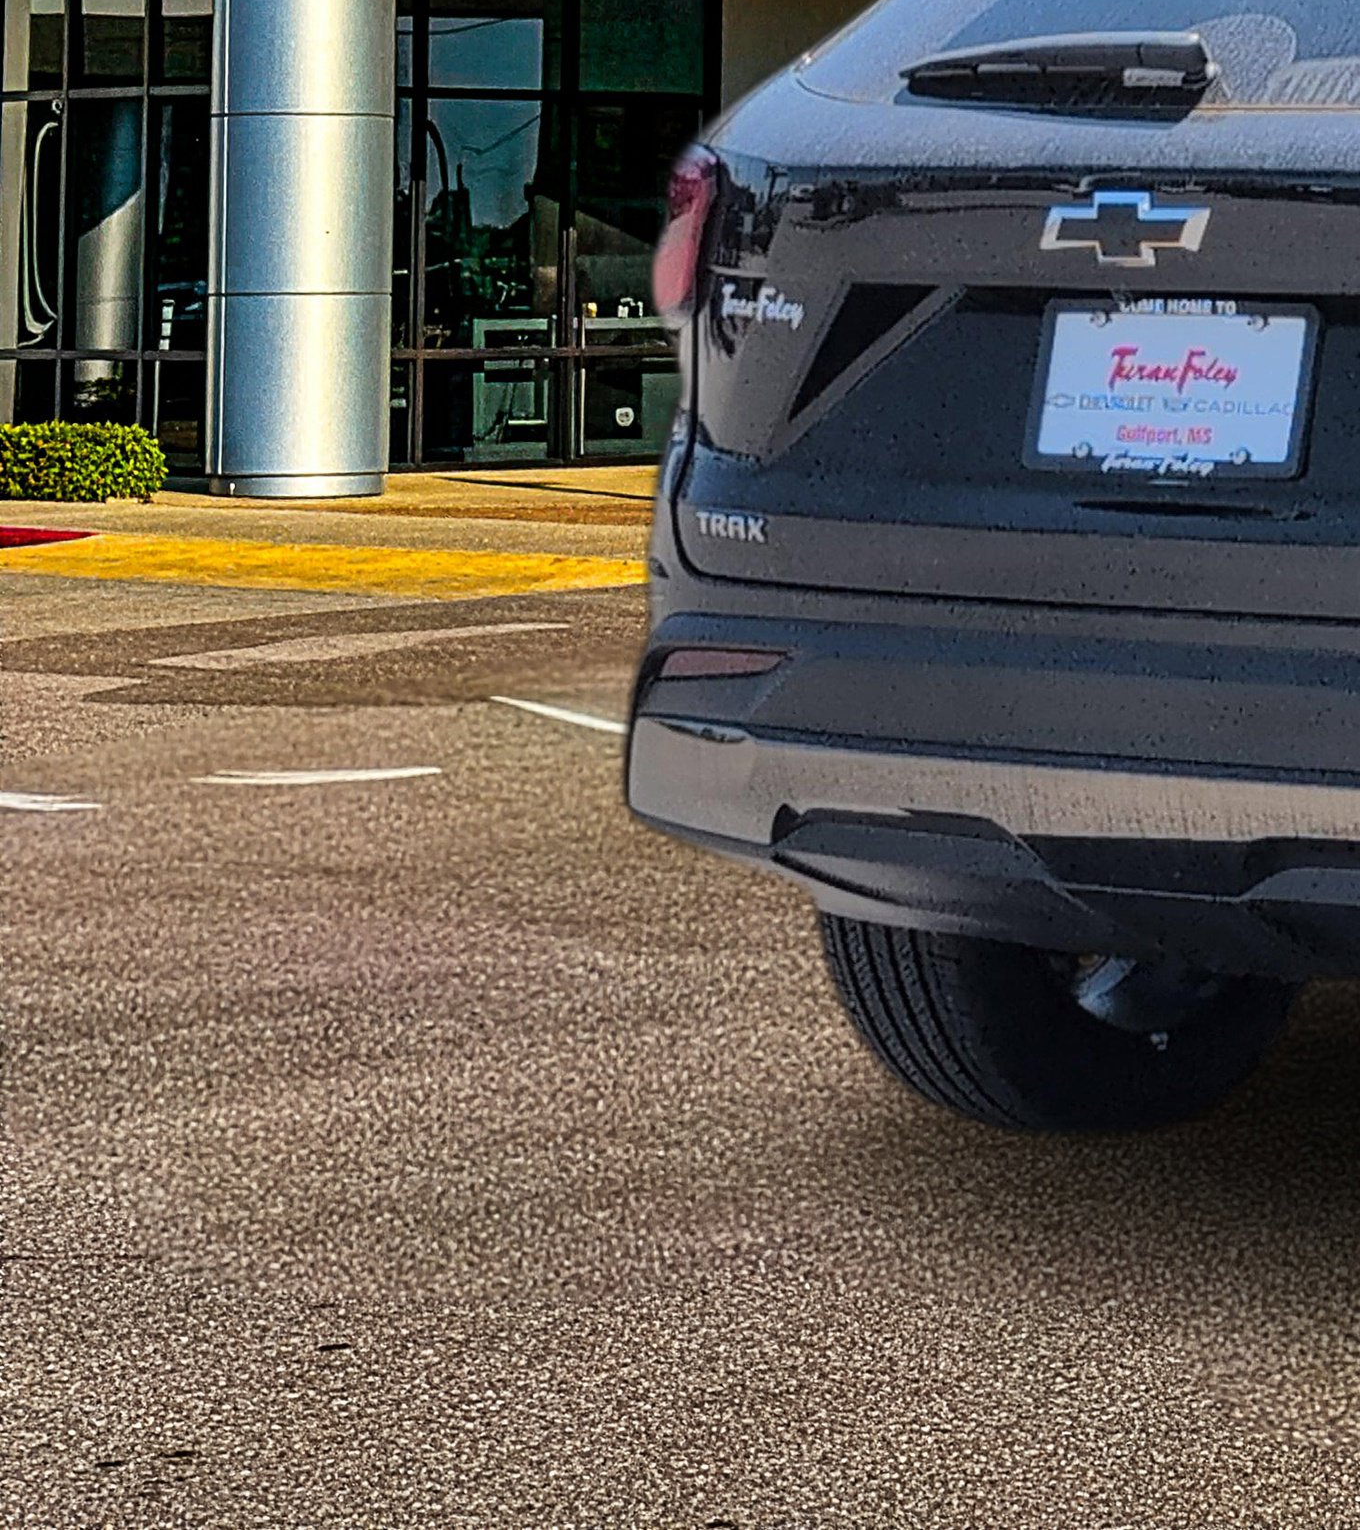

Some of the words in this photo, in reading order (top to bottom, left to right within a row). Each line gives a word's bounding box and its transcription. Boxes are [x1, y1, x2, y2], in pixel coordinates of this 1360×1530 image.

[1215, 300, 1237, 316] TO
[1193, 397, 1292, 417] CADILLAC
[1186, 425, 1213, 446] MS
[696, 511, 768, 544] TRAX
